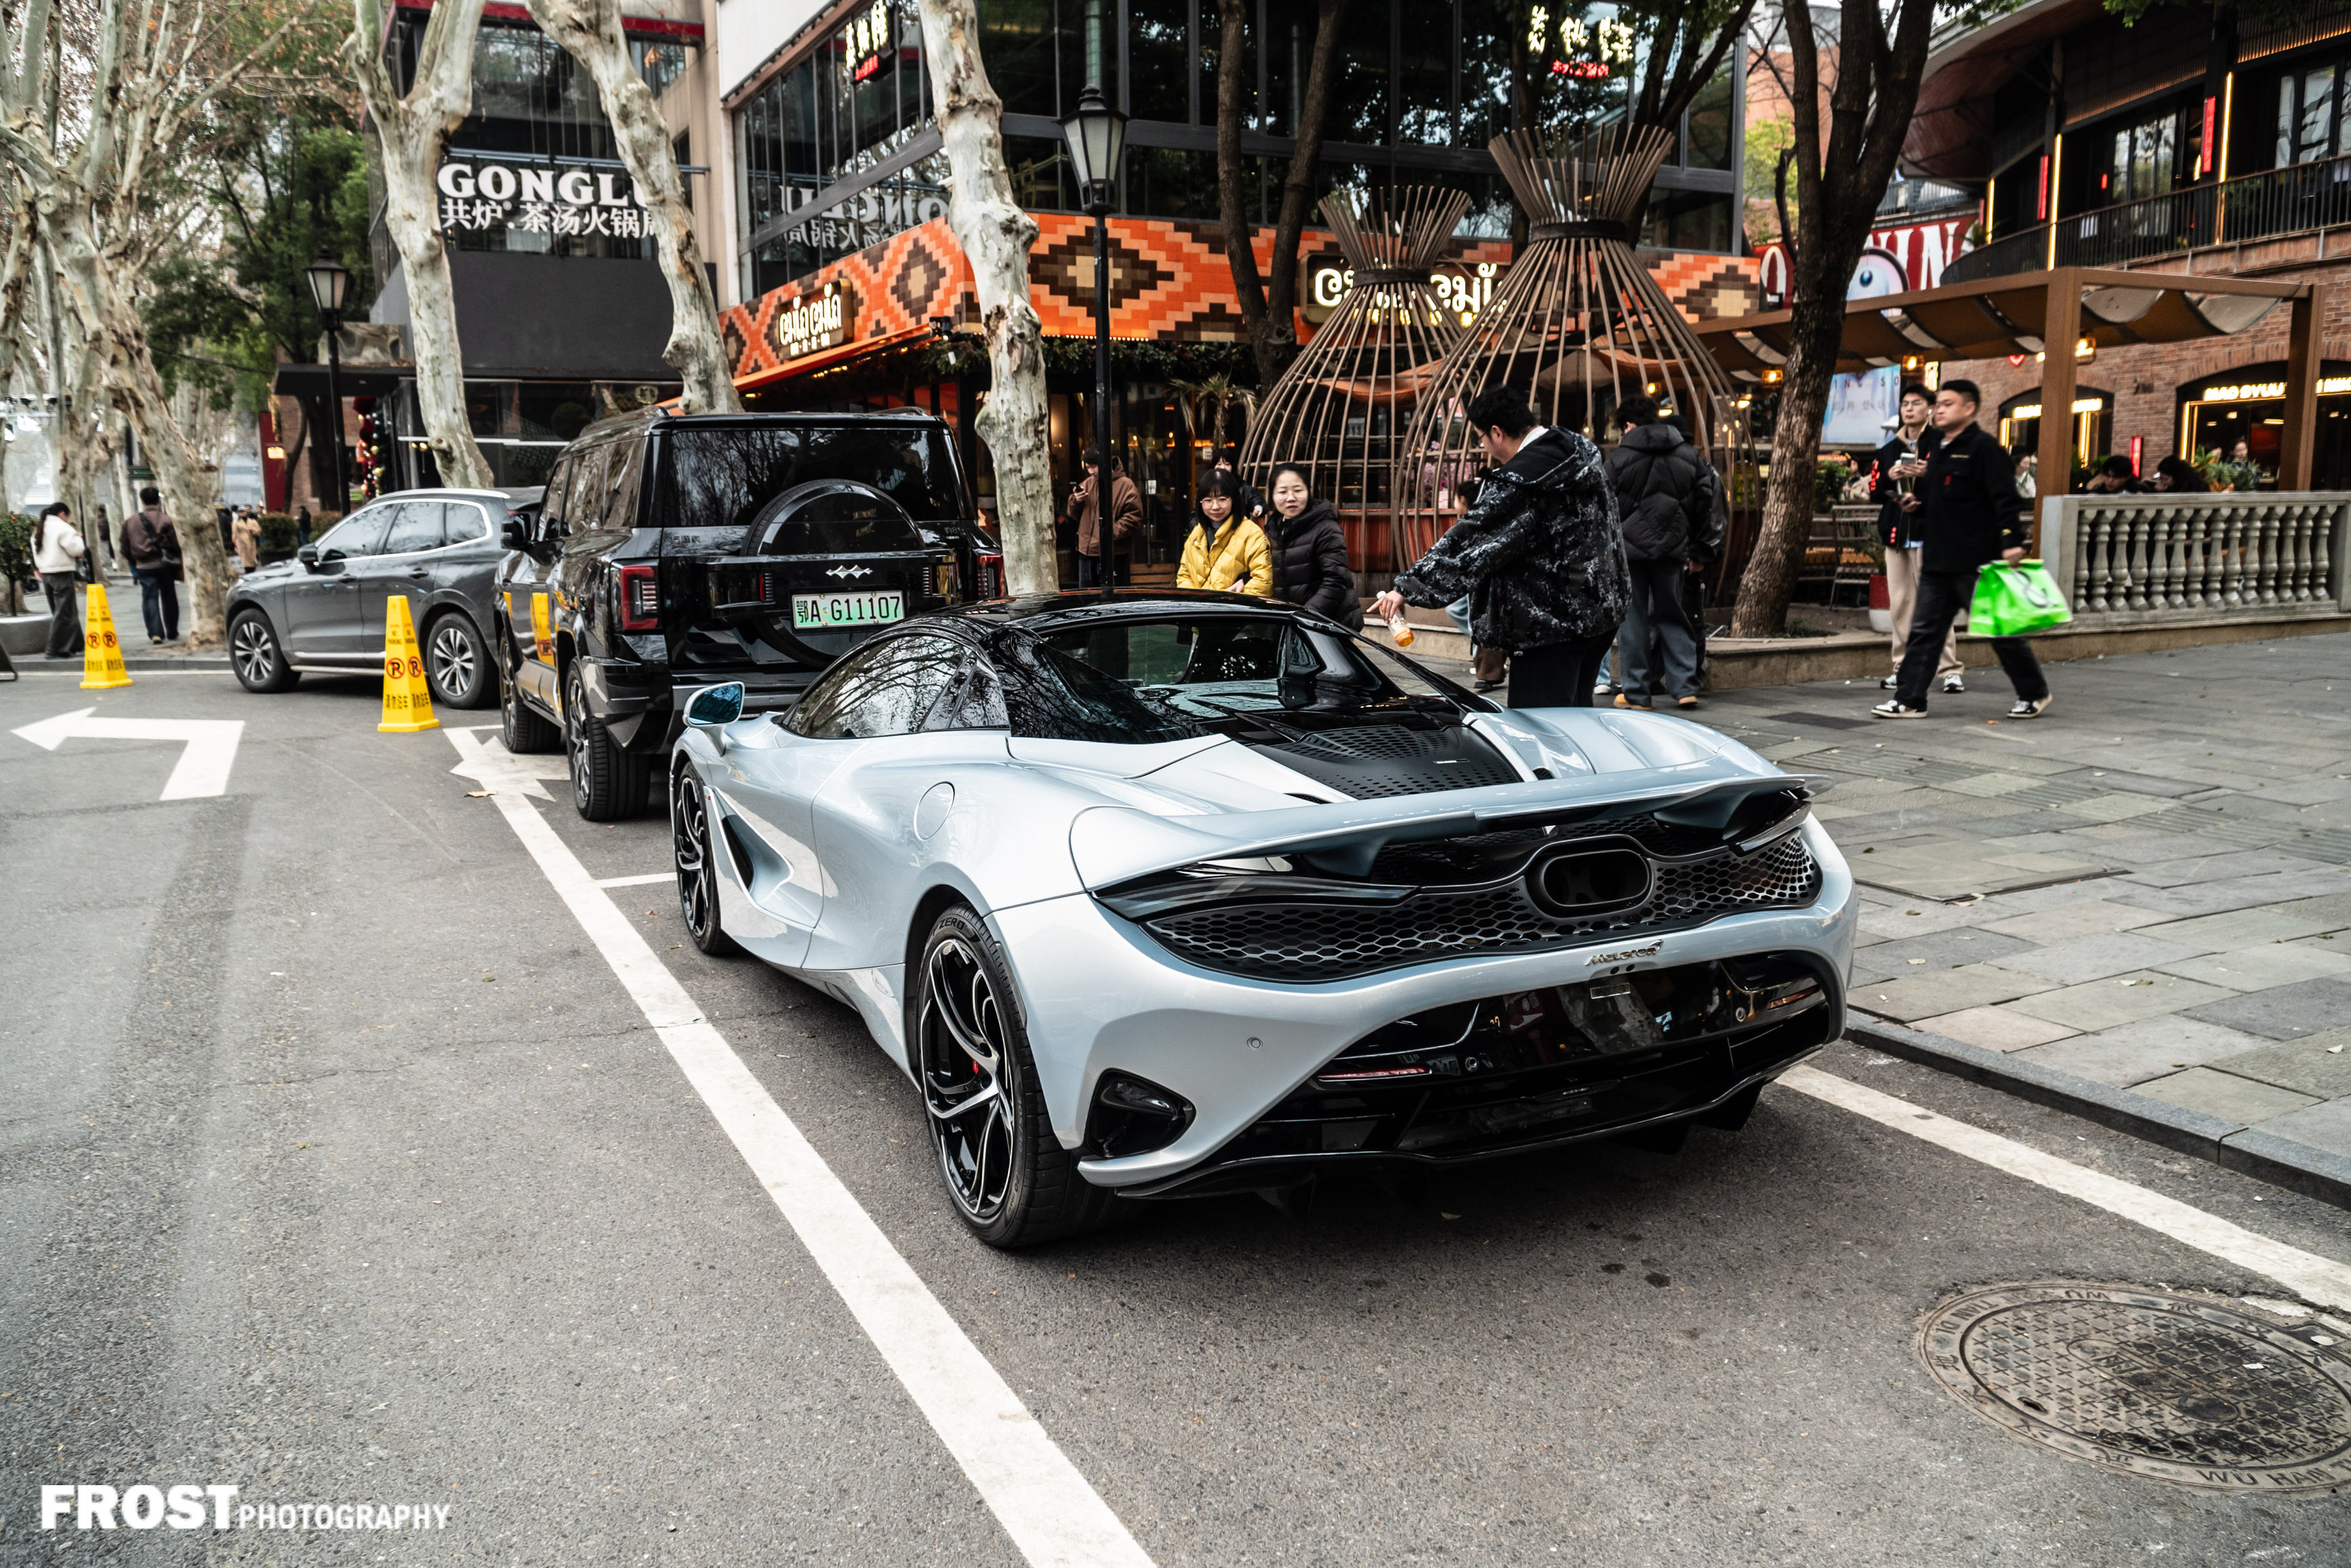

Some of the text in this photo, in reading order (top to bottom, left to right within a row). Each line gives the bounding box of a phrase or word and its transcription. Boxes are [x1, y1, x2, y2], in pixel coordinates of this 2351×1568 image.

[831, 597, 900, 621] G11107
[939, 917, 966, 930] ZERO
[1585, 947, 1656, 966] McLaren
[2266, 1468, 2336, 1486] HAN
